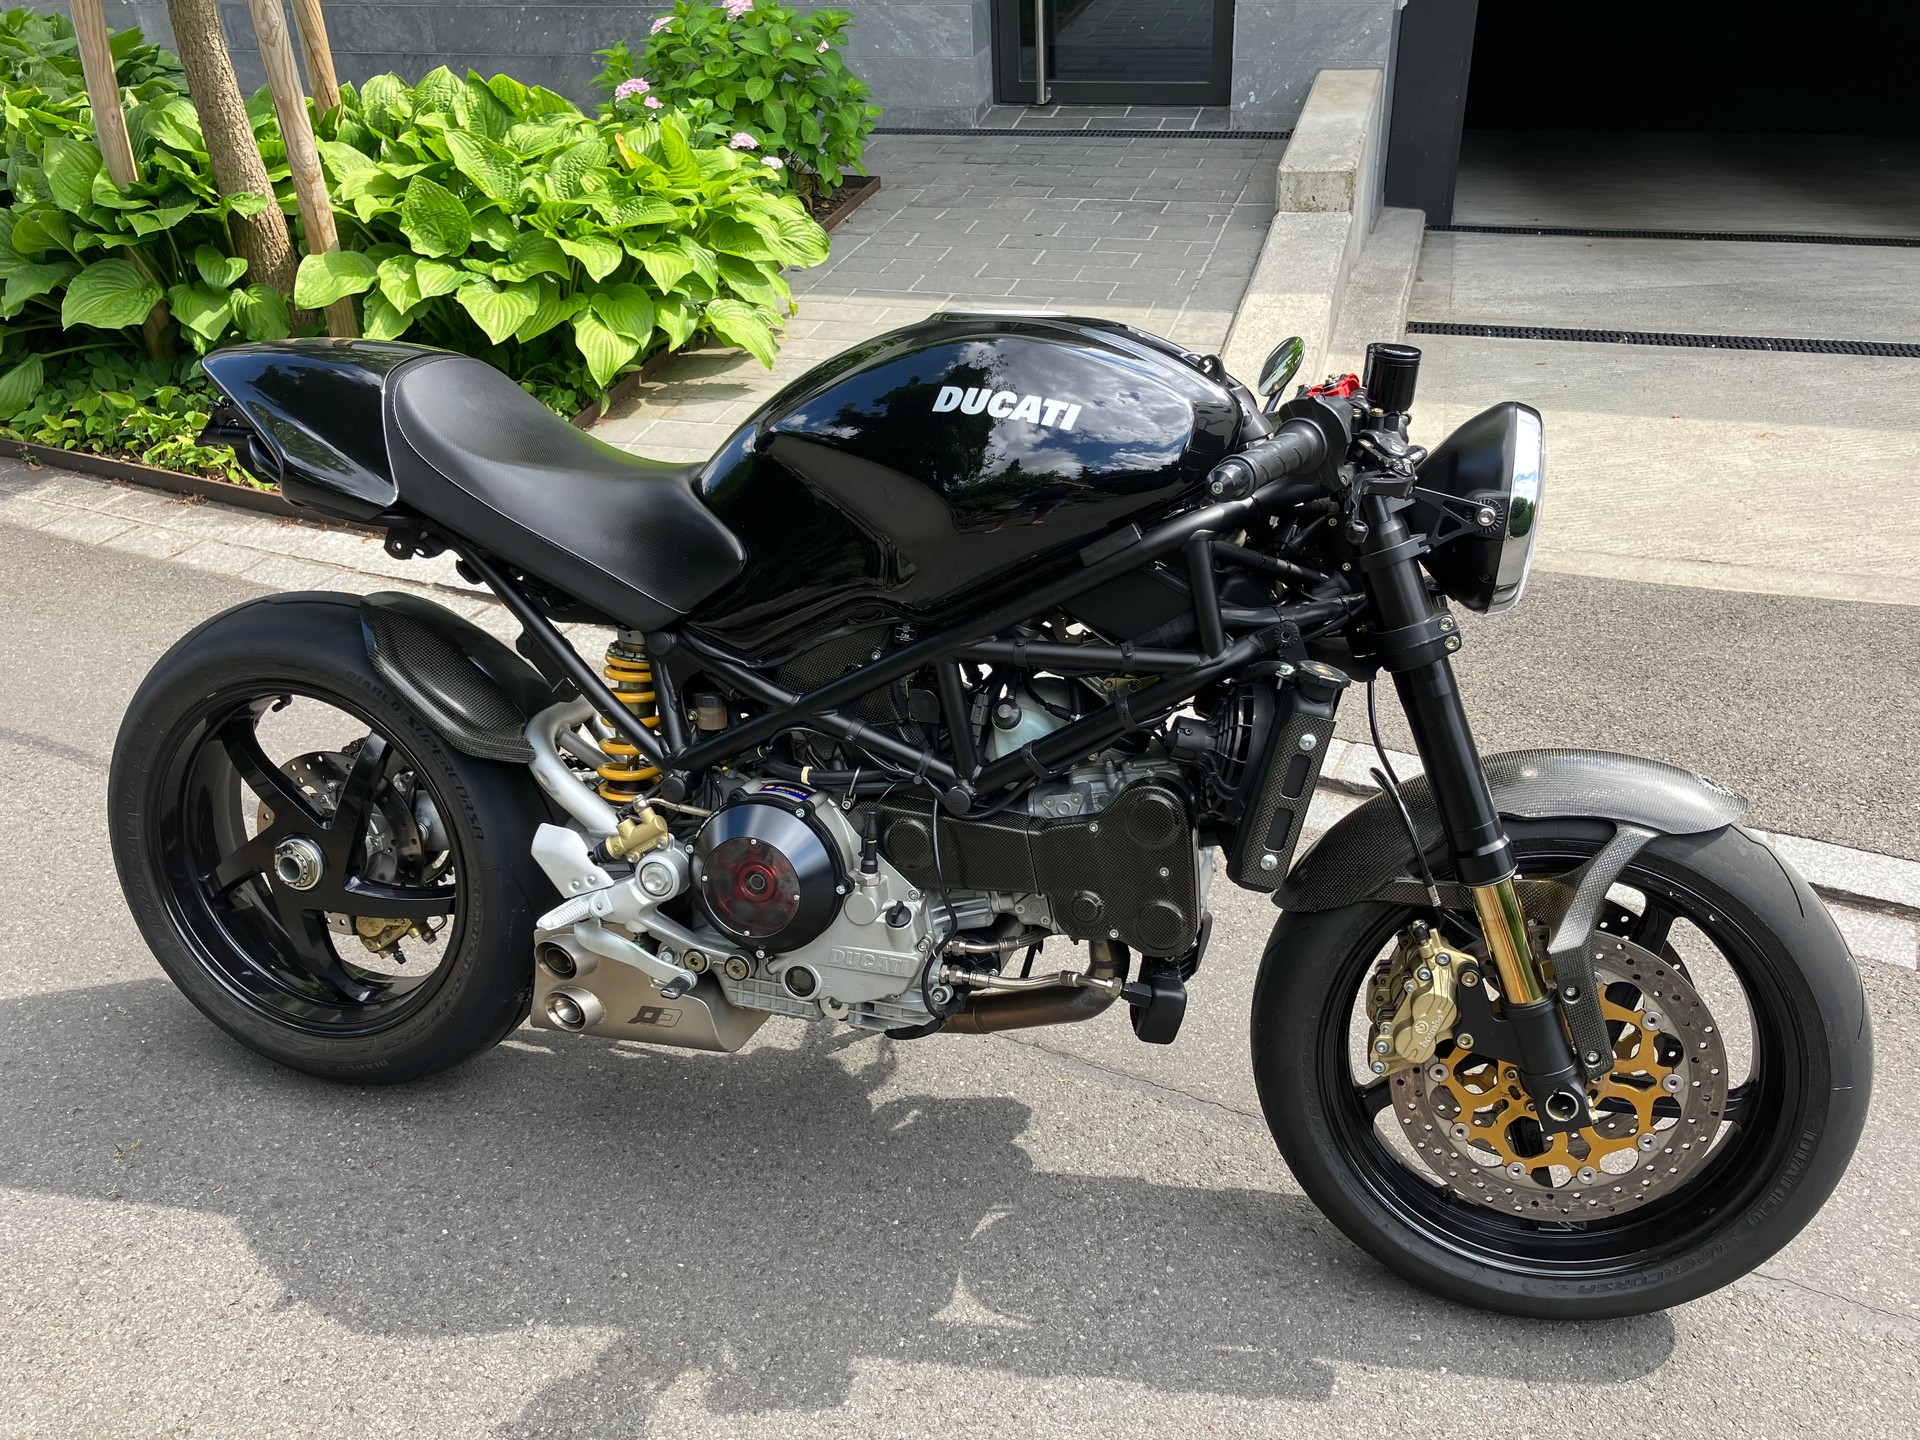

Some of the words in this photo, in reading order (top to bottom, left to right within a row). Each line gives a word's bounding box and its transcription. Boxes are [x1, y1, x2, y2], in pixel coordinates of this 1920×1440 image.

[932, 386, 1082, 431] DUCATI
[346, 670, 400, 713] DIABLO
[404, 716, 485, 841] SUPERCORSA
[828, 948, 909, 975] DUCATI
[1747, 1128, 1819, 1229] DIABLO
[1576, 1231, 1743, 1296] SUPERCORSA
